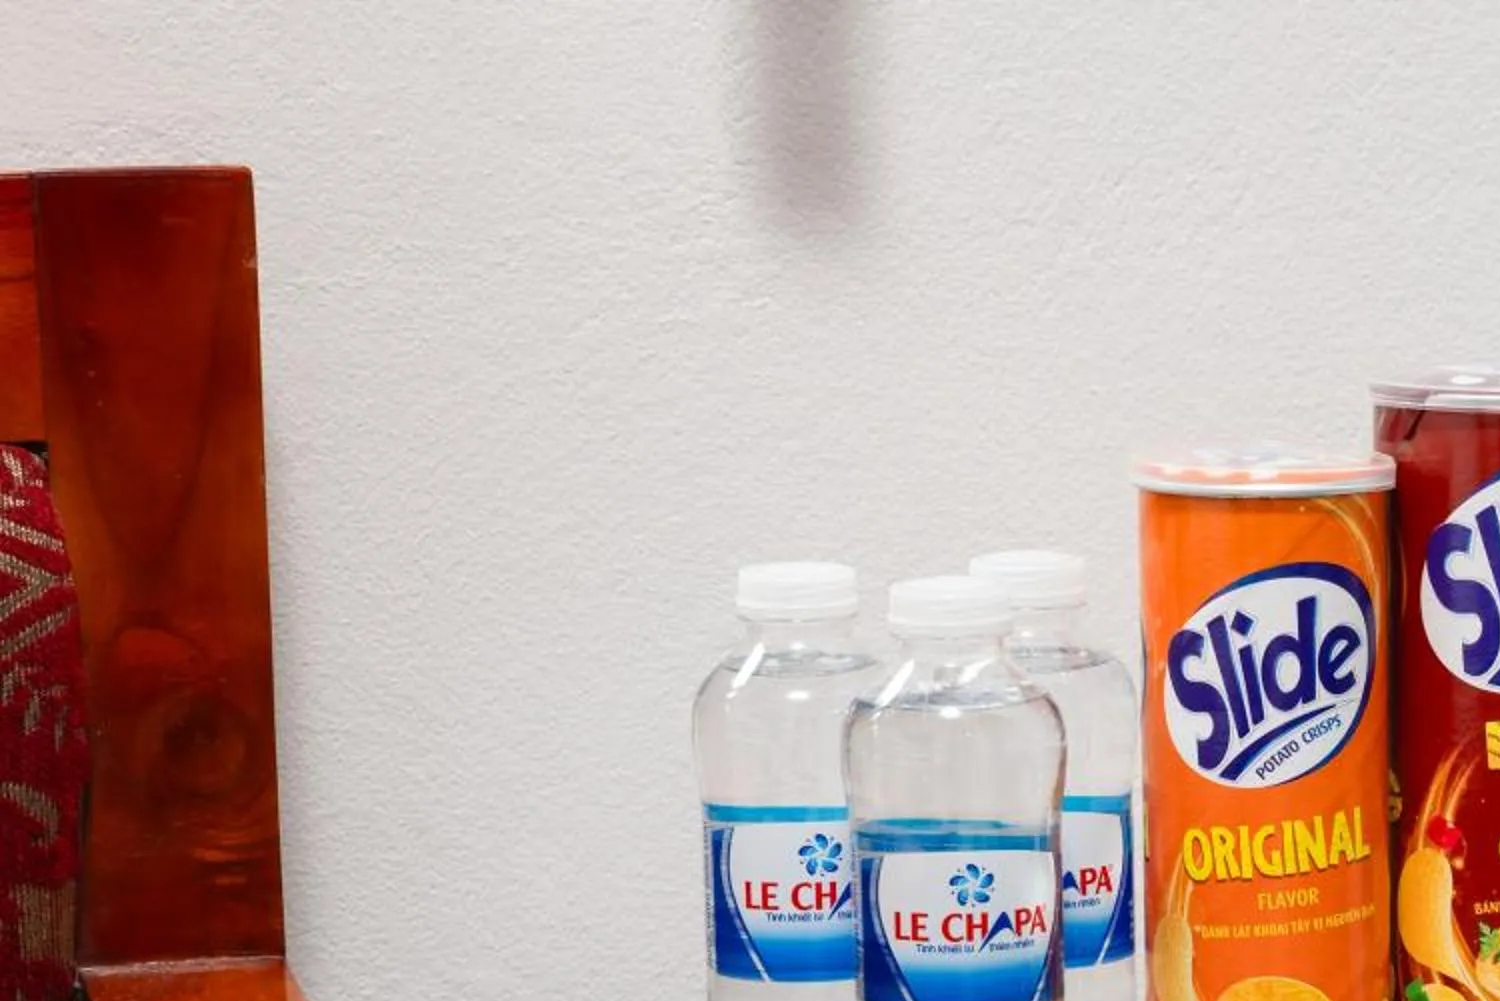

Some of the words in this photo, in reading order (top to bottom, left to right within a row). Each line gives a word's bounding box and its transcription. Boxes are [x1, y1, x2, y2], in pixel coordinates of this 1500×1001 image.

[1167, 595, 1361, 770] Slide
[1255, 740, 1300, 780] POTATO
[1301, 713, 1343, 745] CRISPS
[1182, 806, 1371, 882] ORIGINAL
[744, 881, 779, 910] LE
[1257, 887, 1320, 911] FLAVOR
[894, 910, 929, 942] LE
[941, 905, 1047, 952] CHAPA
